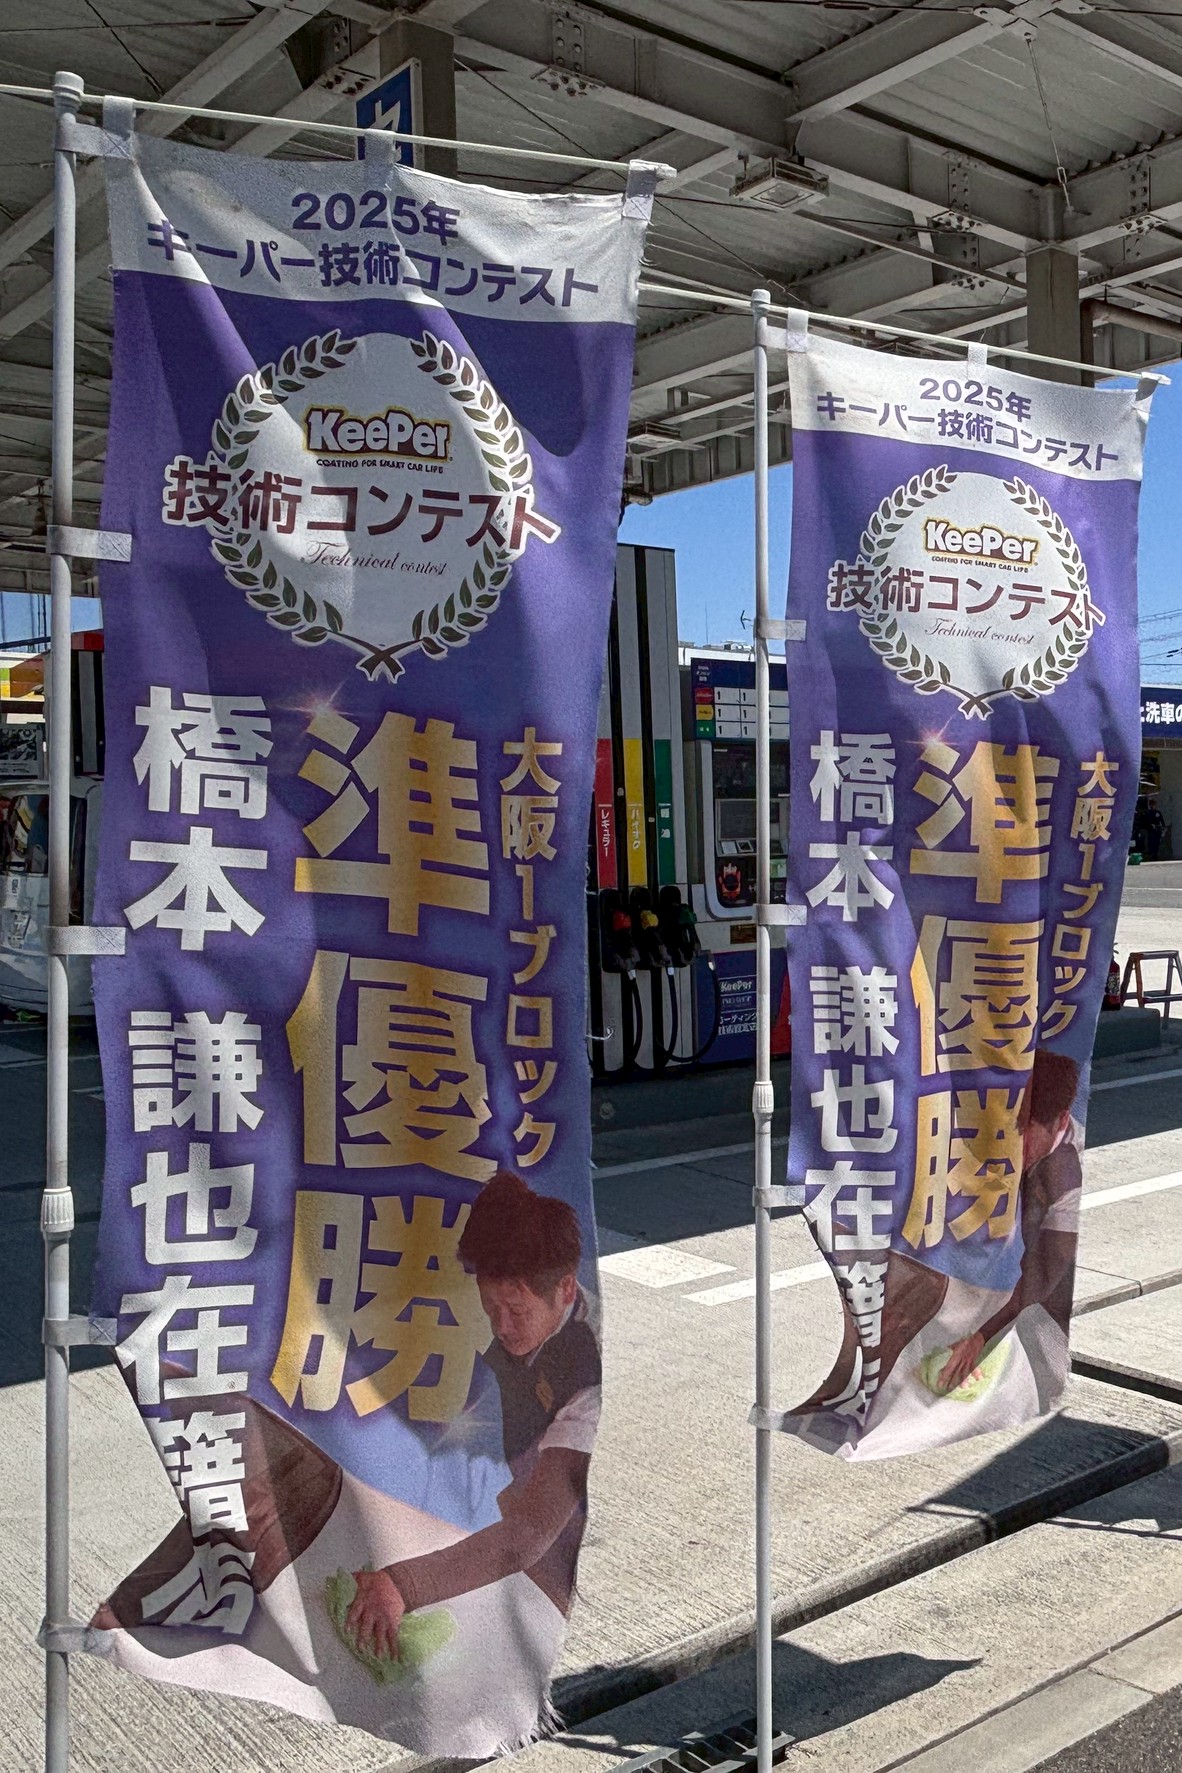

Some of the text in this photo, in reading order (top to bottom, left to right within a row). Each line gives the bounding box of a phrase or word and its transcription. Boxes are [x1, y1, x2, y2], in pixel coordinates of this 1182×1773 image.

[292, 191, 459, 246] 2025年
[147, 220, 599, 308] キーパー技術コンテスト
[919, 377, 1032, 422] 2025年
[307, 408, 450, 460] KeePer
[816, 391, 1119, 471] キーパー技術コンテスト
[361, 459, 377, 467] FOR
[407, 462, 423, 472] CAR
[166, 461, 556, 550] 技術コンテスト
[306, 540, 400, 570] Technical
[925, 520, 1038, 564] KeePer
[830, 563, 1104, 630] 技術コンテスト
[925, 617, 988, 640] Technical
[902, 741, 1059, 1249] 準優勝
[270, 711, 499, 1421] 準優勝
